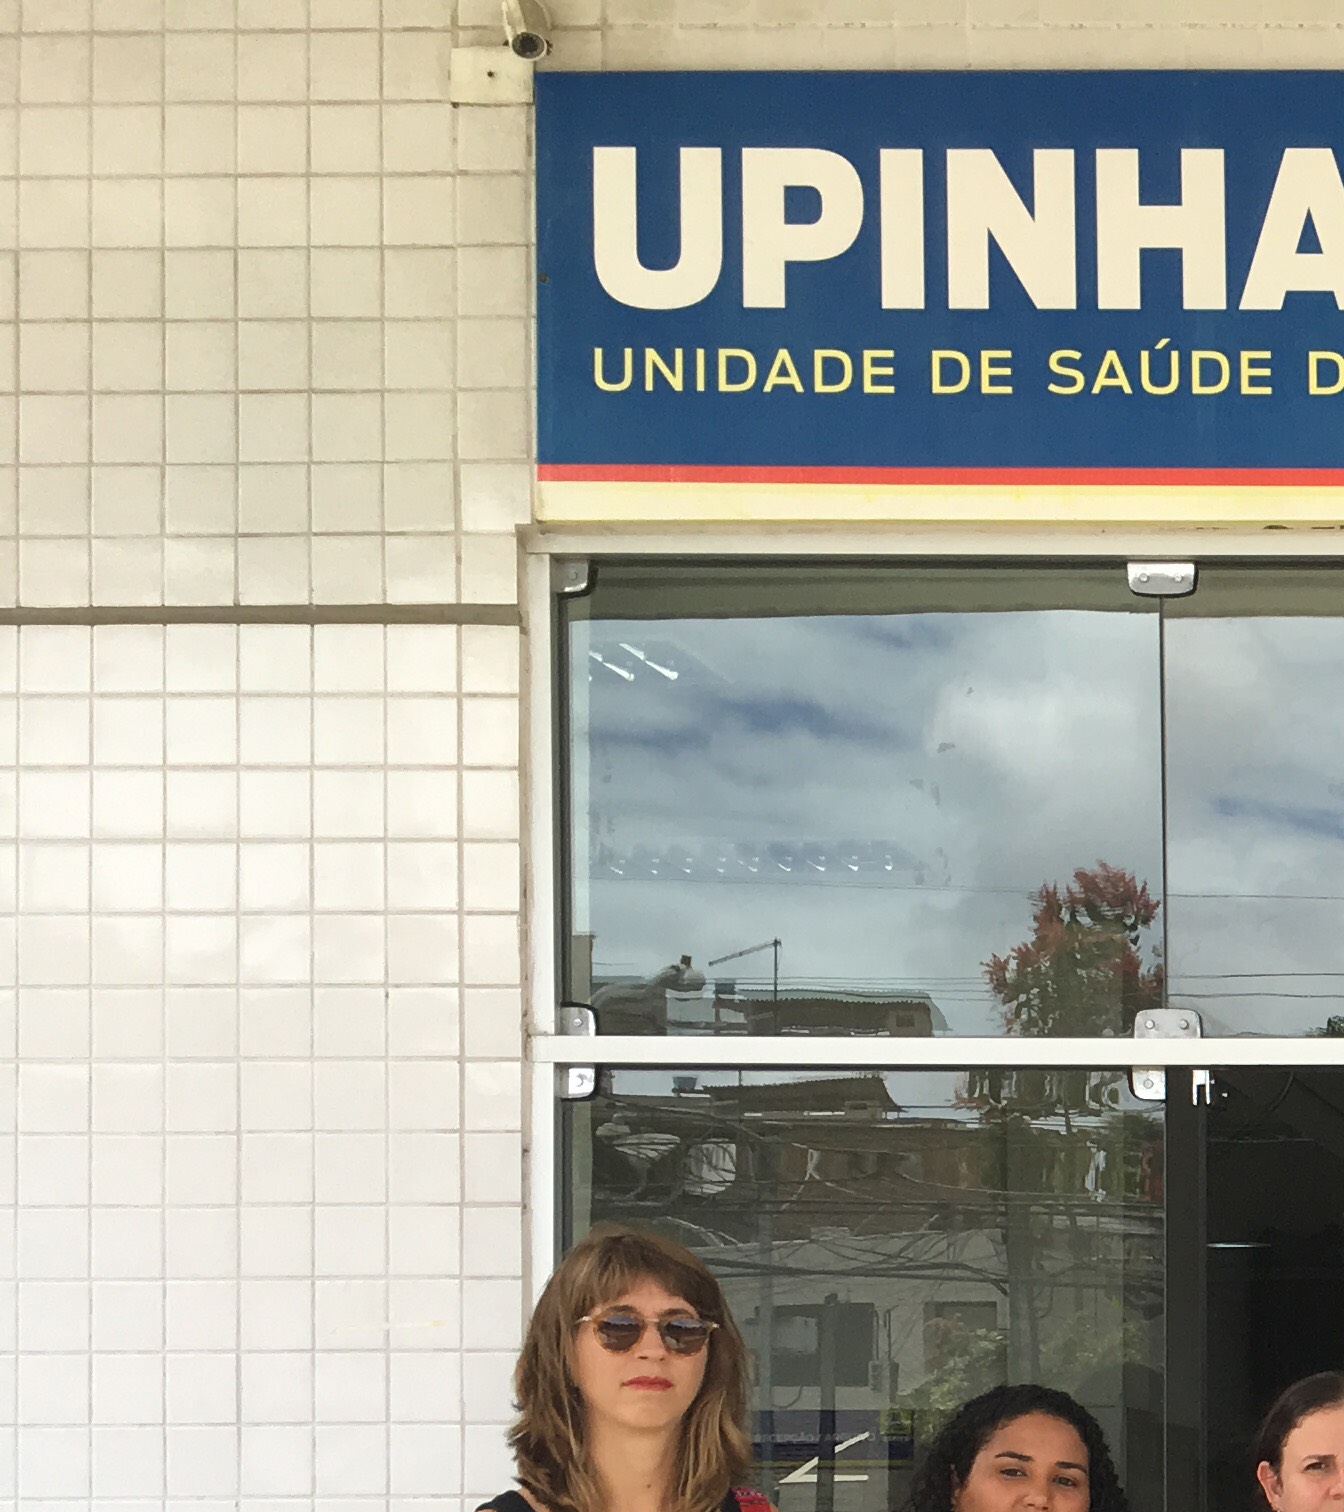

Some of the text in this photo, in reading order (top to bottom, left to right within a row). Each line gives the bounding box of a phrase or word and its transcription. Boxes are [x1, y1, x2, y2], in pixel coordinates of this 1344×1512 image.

[595, 349, 895, 394] UNIDADE
[932, 350, 1014, 394] DE
[1048, 339, 1273, 395] SAÚDE
